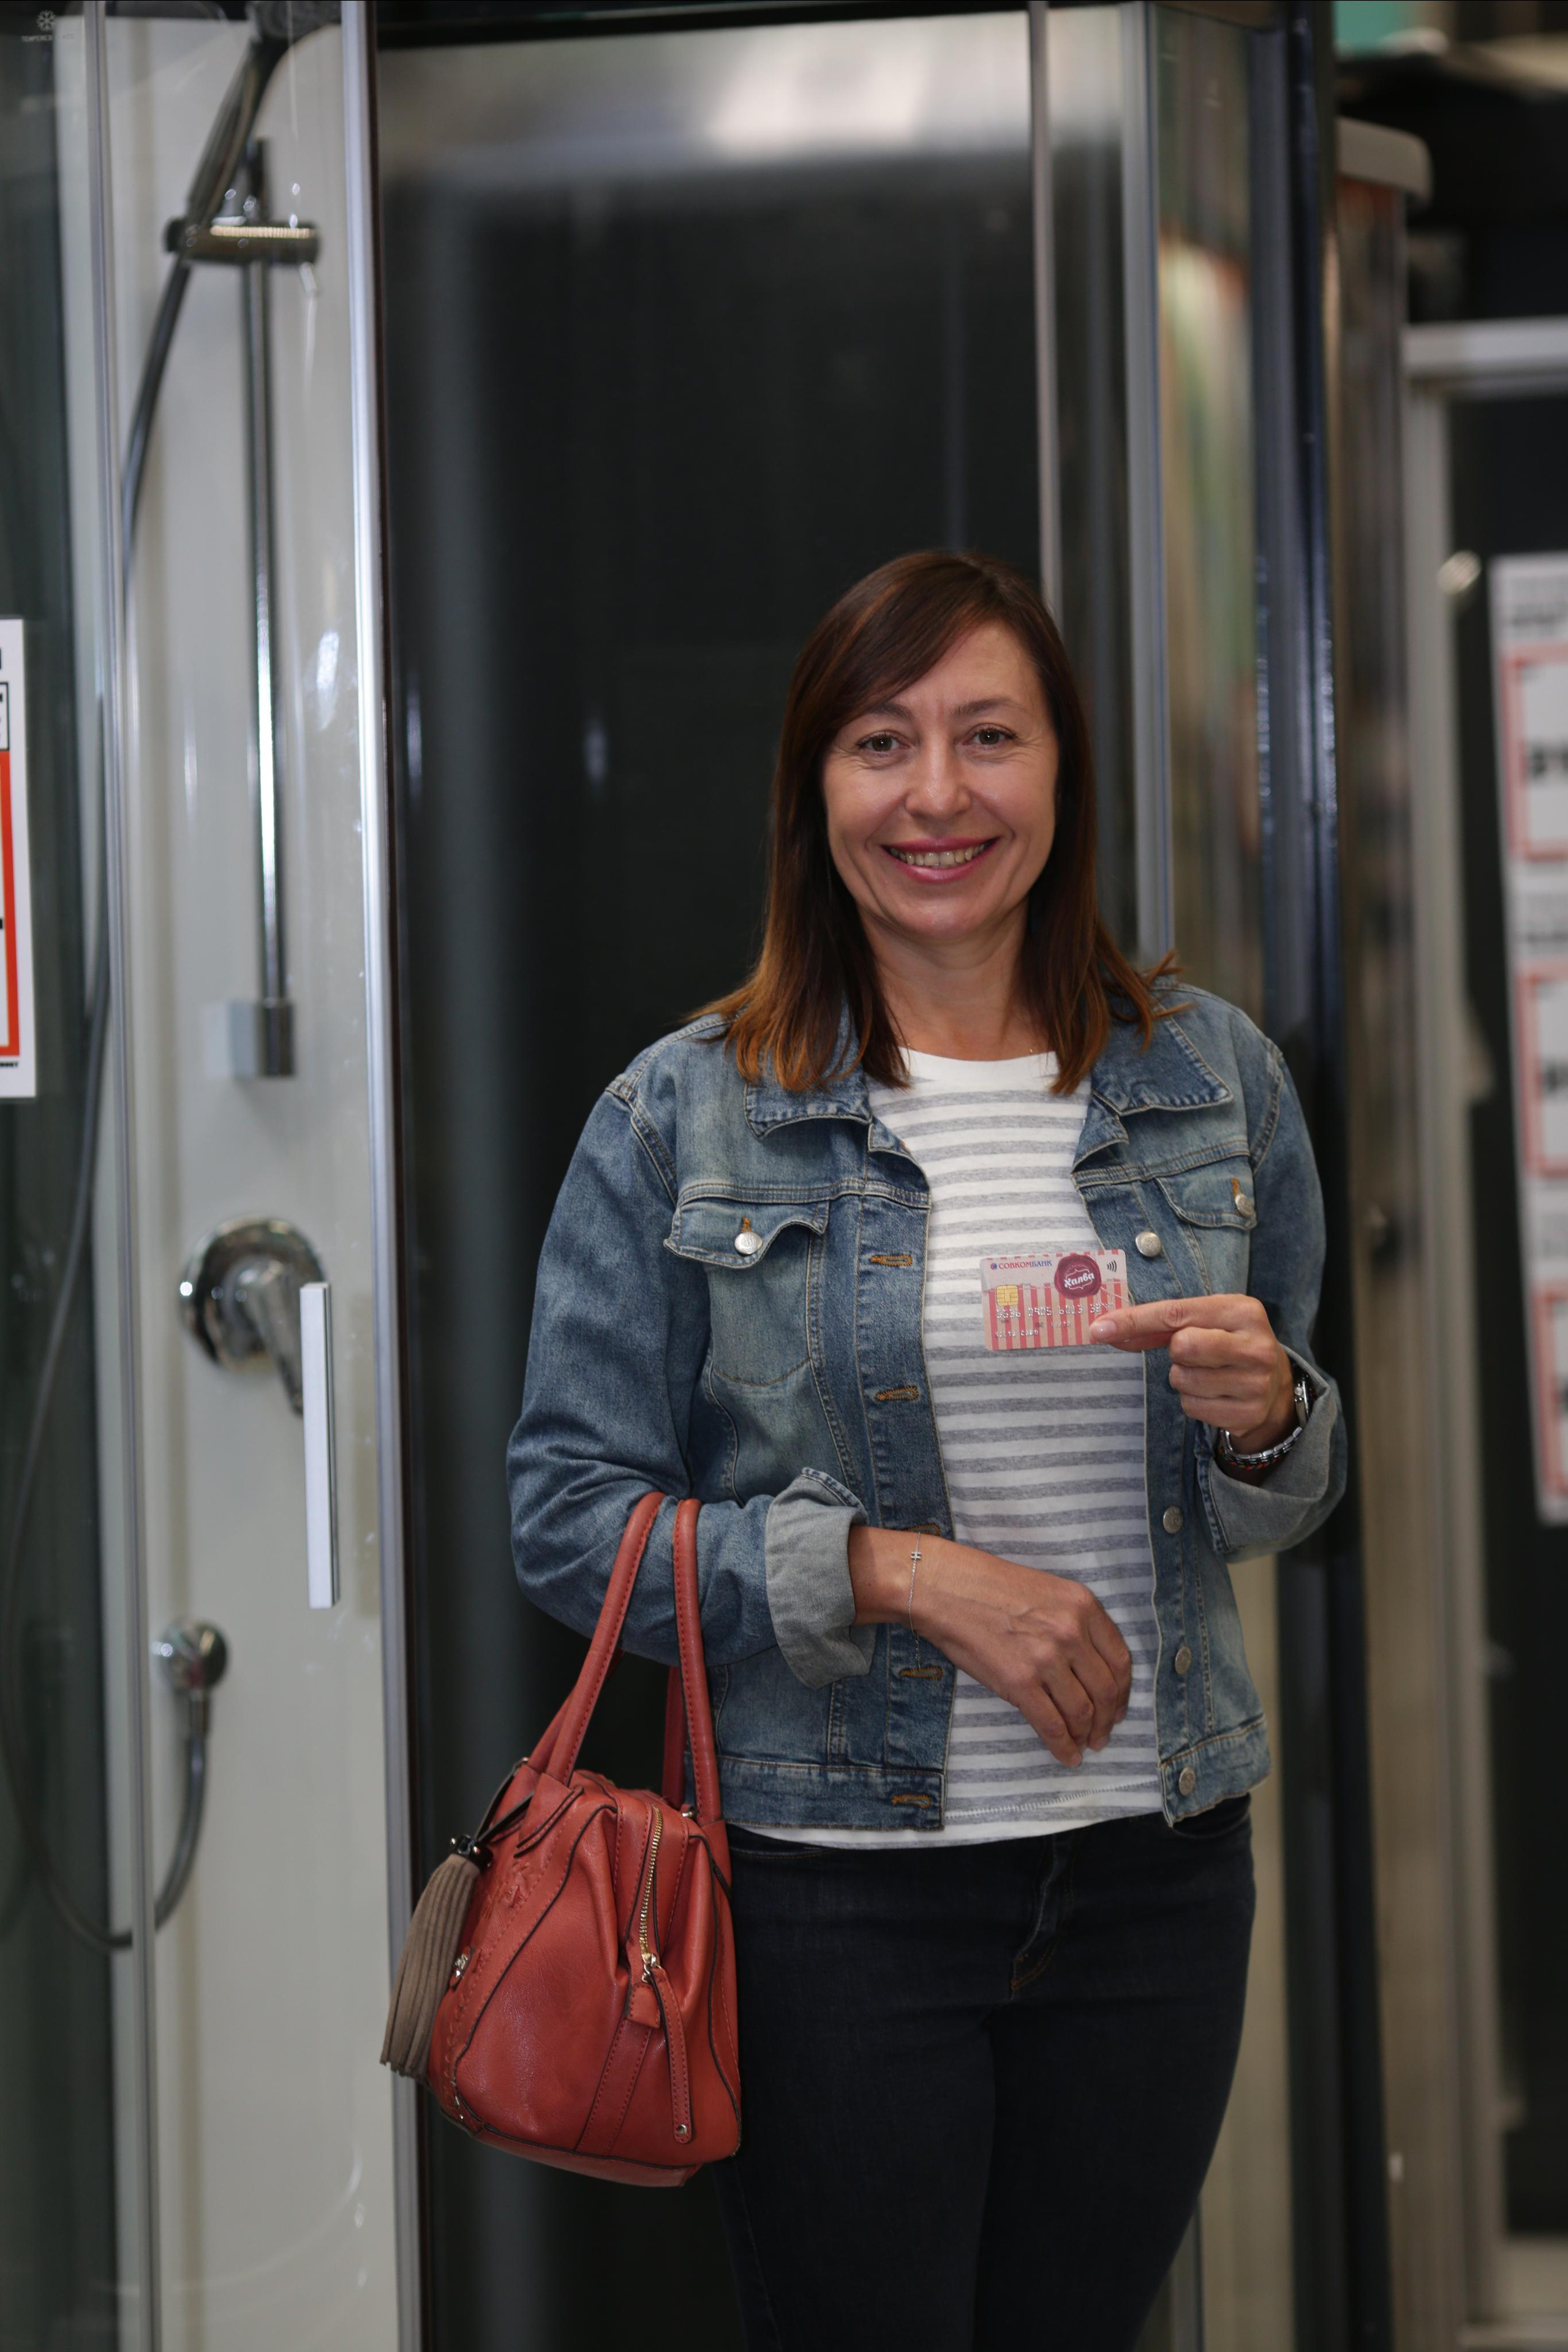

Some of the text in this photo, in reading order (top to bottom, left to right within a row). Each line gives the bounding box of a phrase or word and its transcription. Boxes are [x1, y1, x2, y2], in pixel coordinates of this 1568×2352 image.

[998, 1260, 1052, 1270] СОВКОМБАНК
[1064, 1272, 1095, 1288] Халва
[1058, 1305, 1084, 1315] 6013
